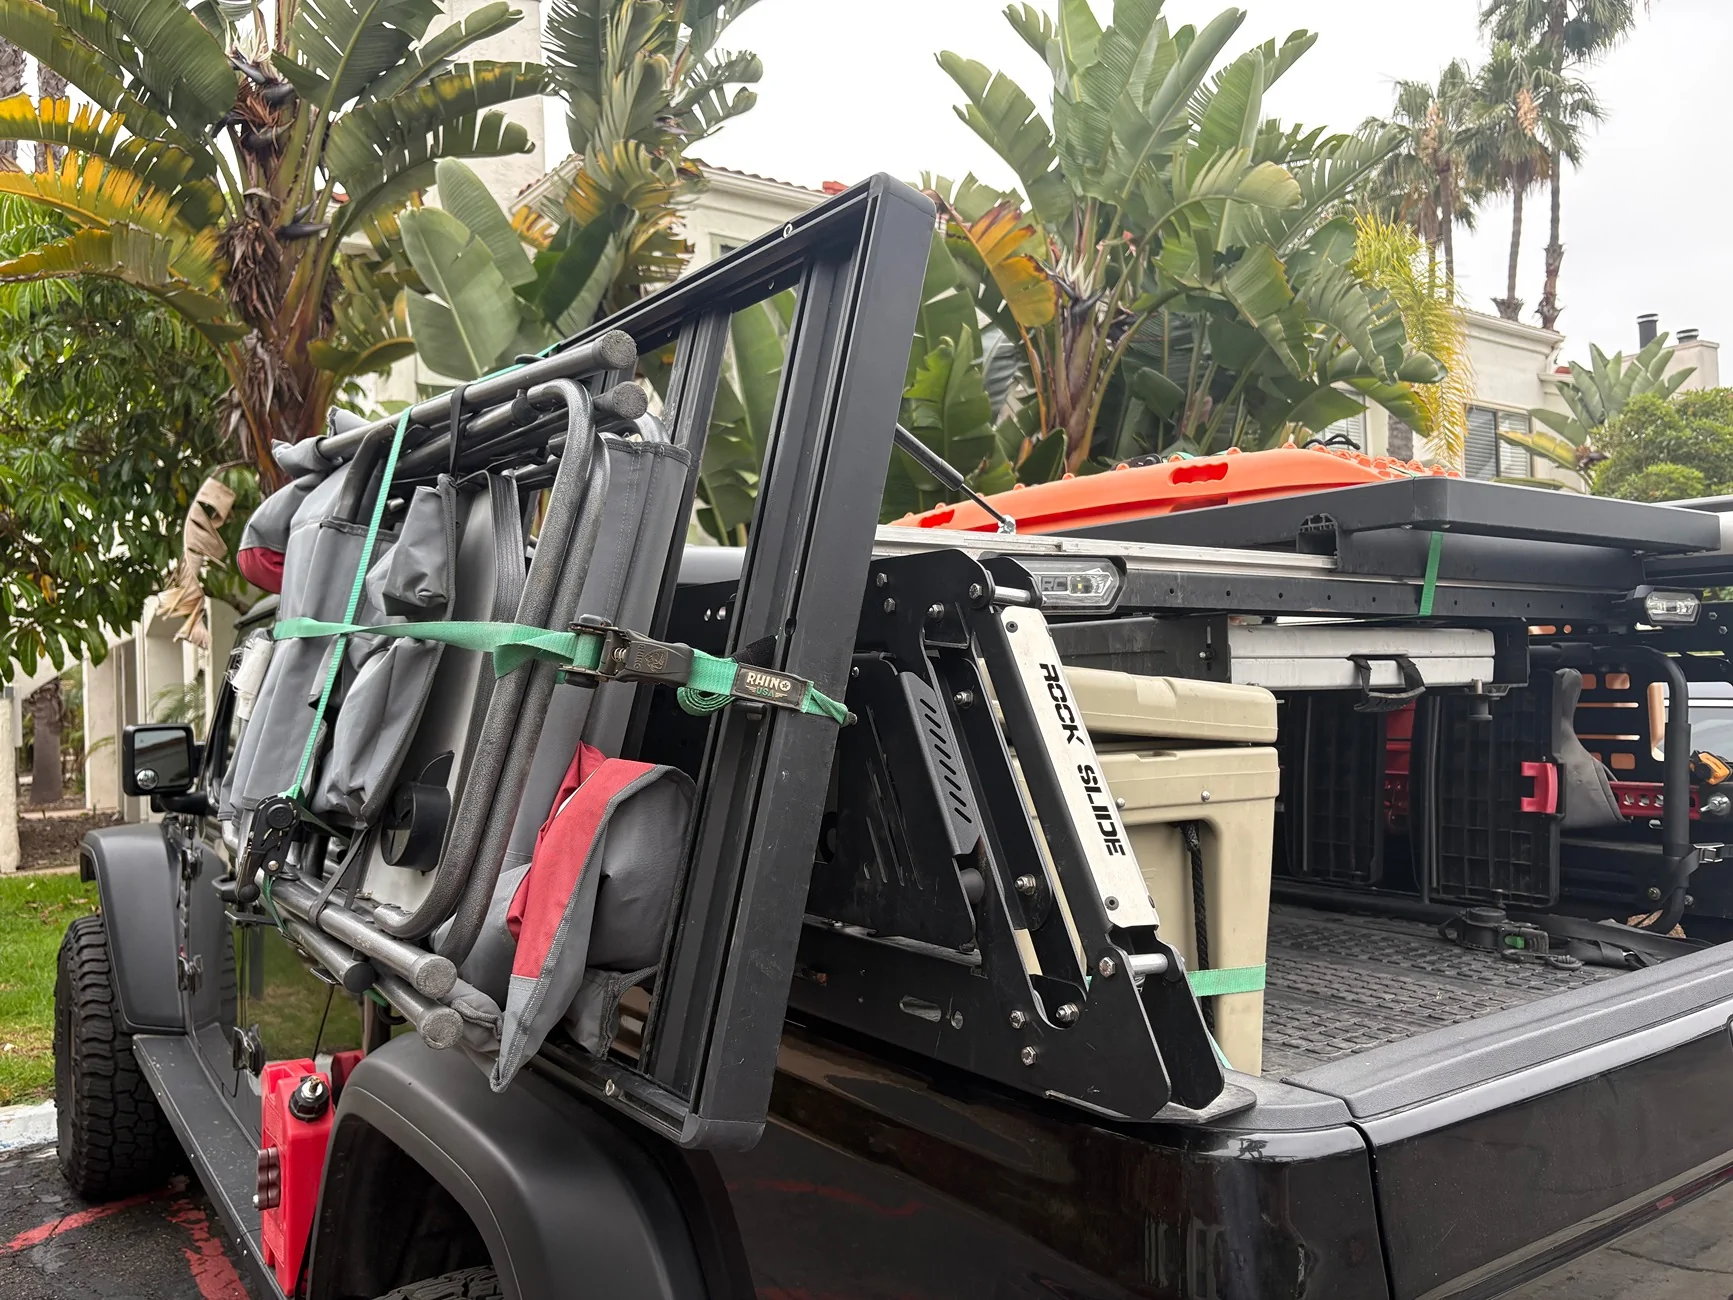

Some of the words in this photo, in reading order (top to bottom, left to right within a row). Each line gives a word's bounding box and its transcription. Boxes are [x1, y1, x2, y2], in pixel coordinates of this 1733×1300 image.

[746, 672, 791, 692] RHINO
[756, 686, 775, 698] USA
[1039, 662, 1086, 747] ROCK
[1077, 763, 1127, 857] SLIDE
